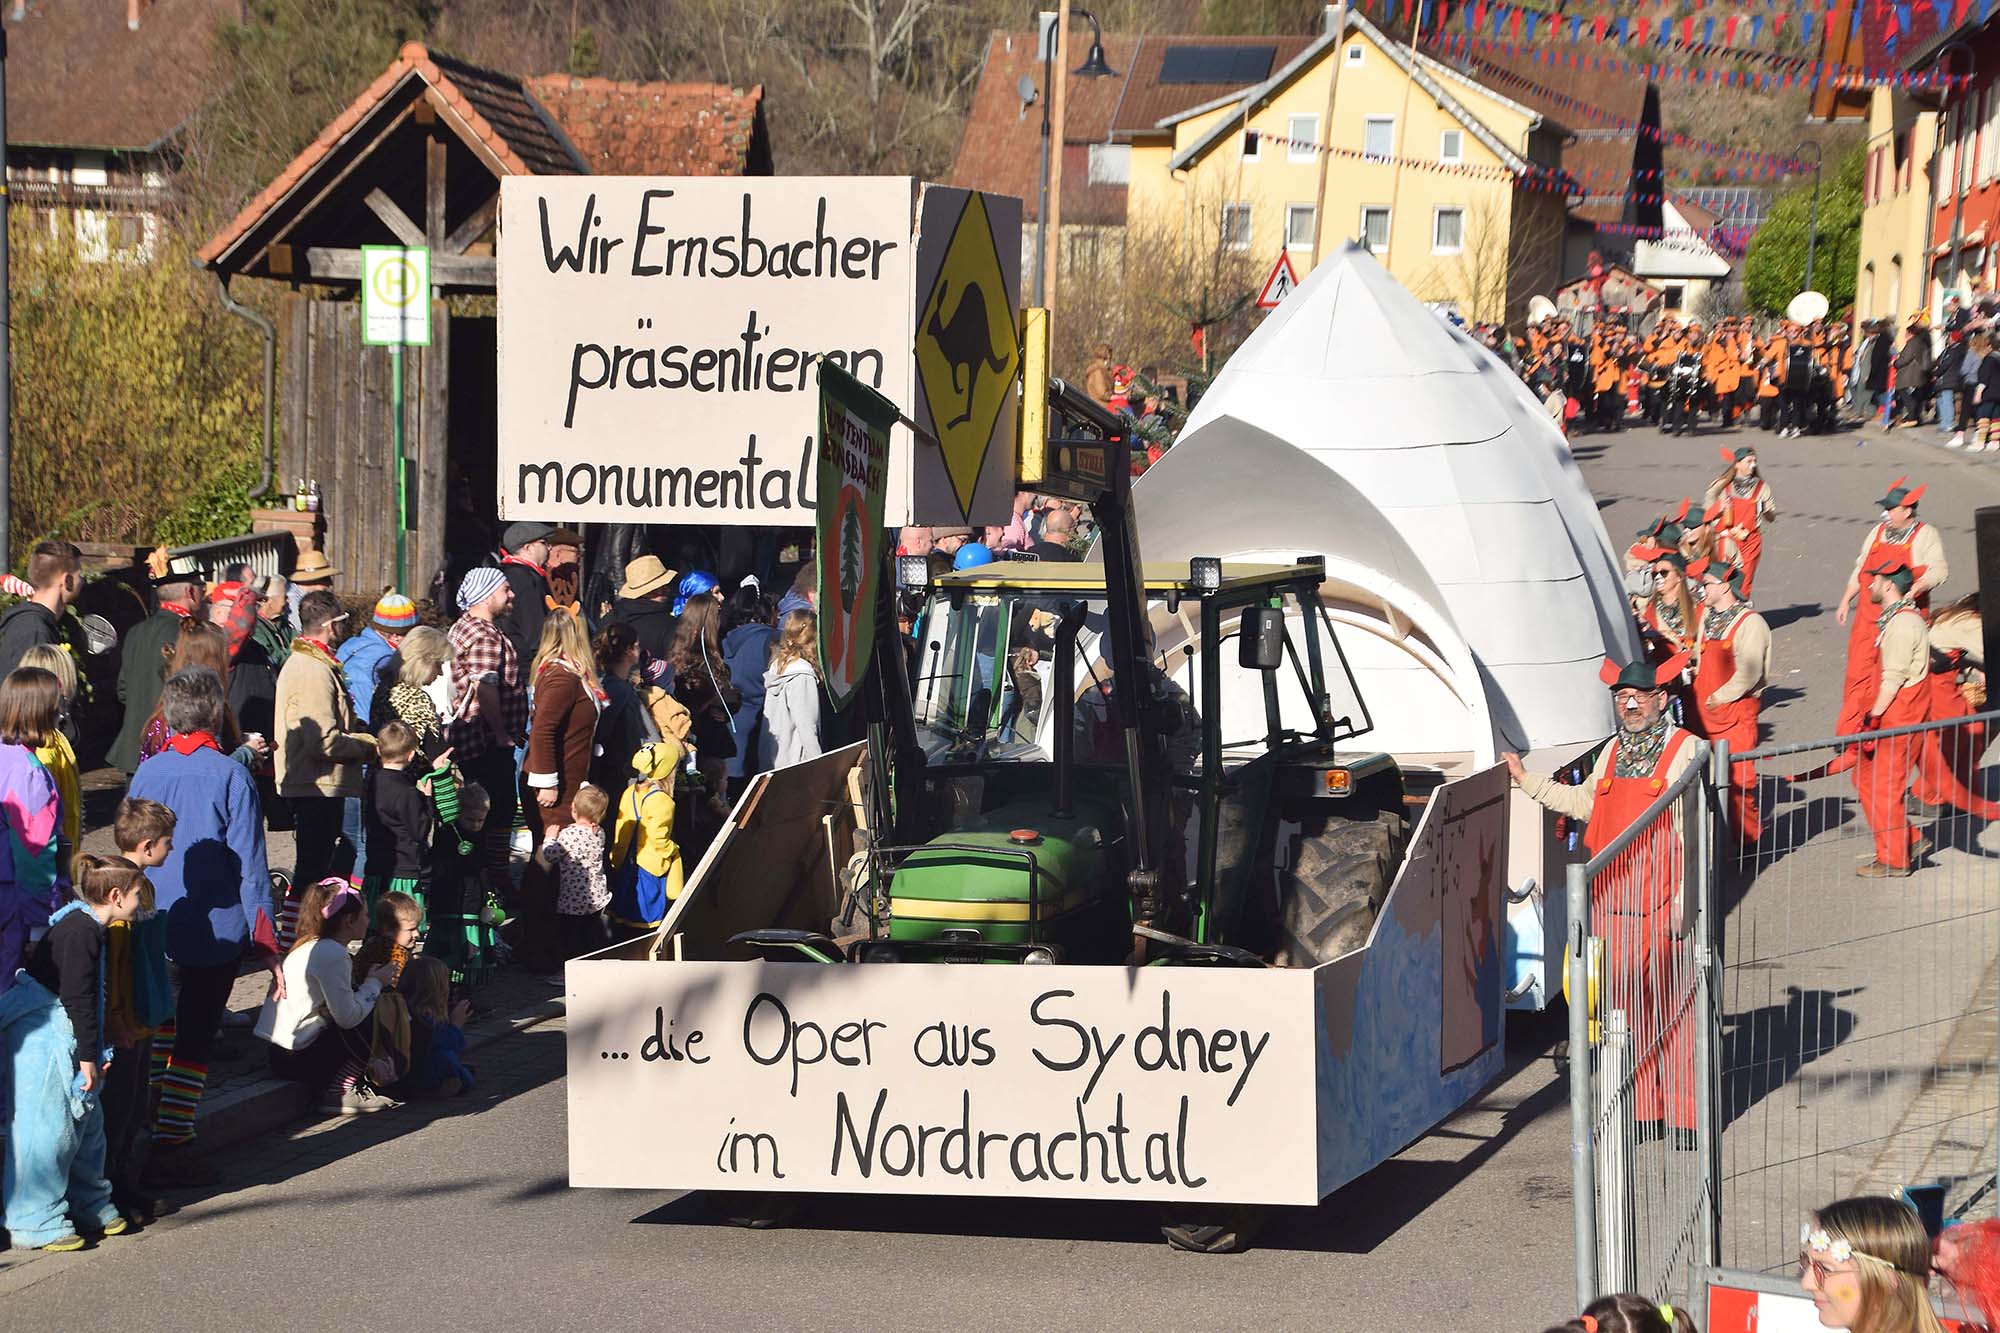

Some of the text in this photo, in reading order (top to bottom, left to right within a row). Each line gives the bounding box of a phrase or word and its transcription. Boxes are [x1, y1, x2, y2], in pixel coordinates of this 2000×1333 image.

[538, 189, 898, 281] Wir Ernsbacher
[386, 268, 407, 296] H
[518, 433, 818, 511] monumental
[600, 985, 1271, 1107] ...die Oper aus Sydney
[716, 1088, 1208, 1189] im Nordrachtal
